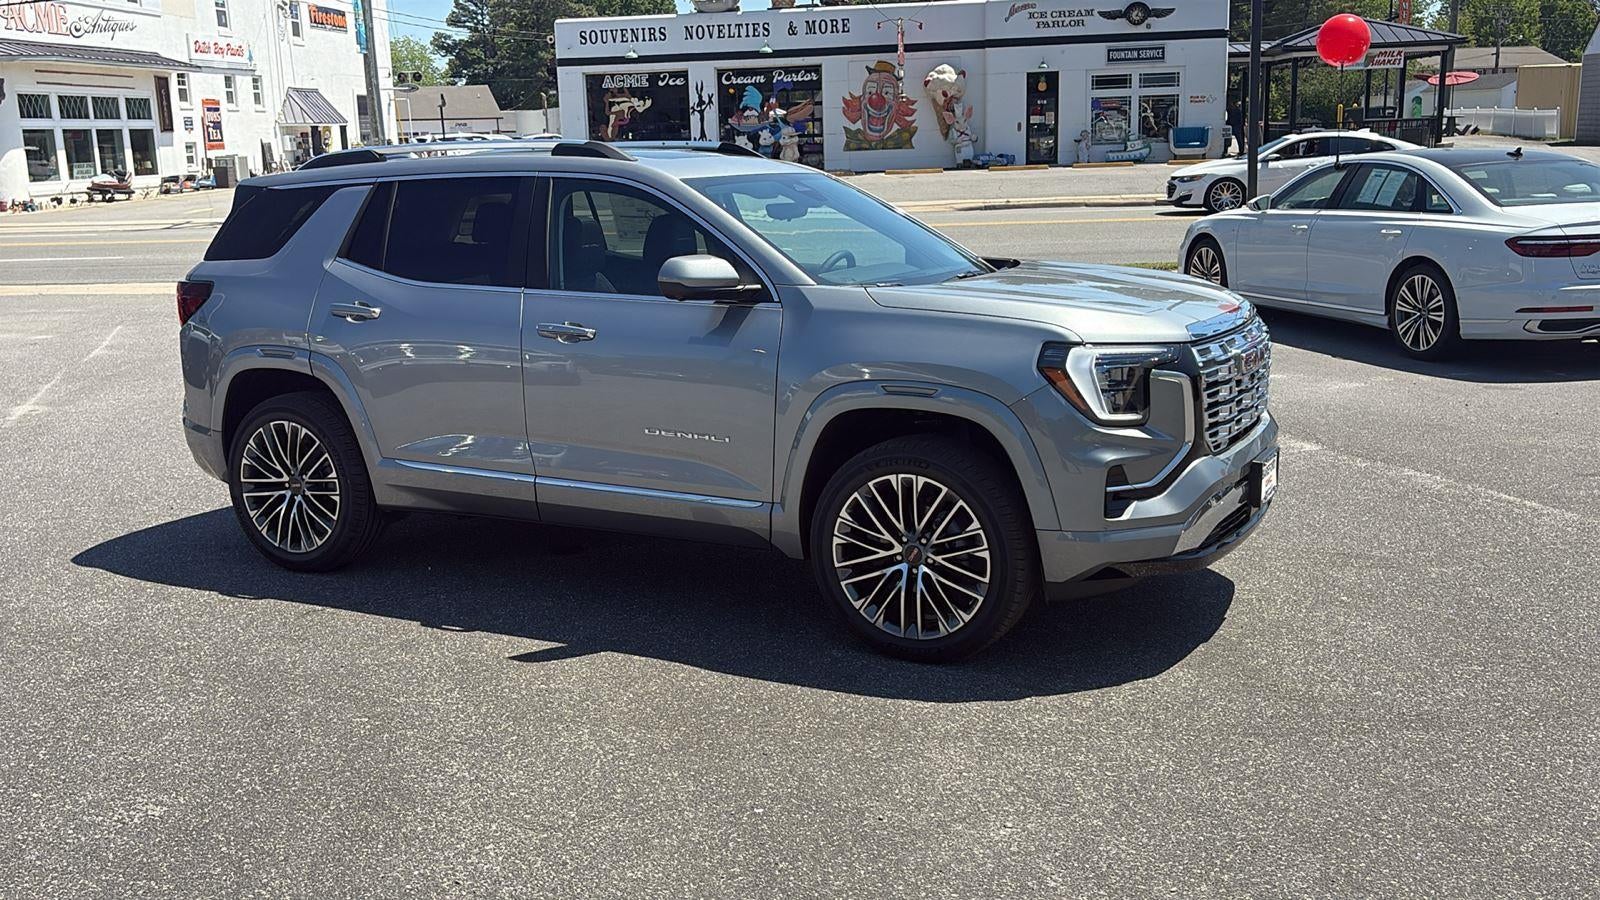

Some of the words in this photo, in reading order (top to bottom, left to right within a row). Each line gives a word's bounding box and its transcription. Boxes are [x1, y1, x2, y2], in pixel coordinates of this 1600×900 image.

[0, 3, 70, 36] ACME
[84, 8, 137, 40] Antiques
[309, 5, 347, 27] Firestone
[1028, 12, 1047, 20] ICE
[1050, 8, 1094, 19] CREAM
[579, 26, 667, 45] SOUVENIRS
[684, 22, 771, 40] NOVELTIES
[787, 20, 798, 36] &
[804, 18, 850, 35] MORE
[1035, 19, 1085, 29] PARLOR
[213, 42, 225, 58] Boy
[1110, 50, 1138, 59] FOUNTAIN
[1139, 49, 1163, 58] SERVICE
[1377, 50, 1403, 58] MILK
[602, 74, 649, 88] ACME
[658, 73, 686, 86] Ice
[721, 71, 766, 84] Cream
[772, 69, 819, 83] Parlor
